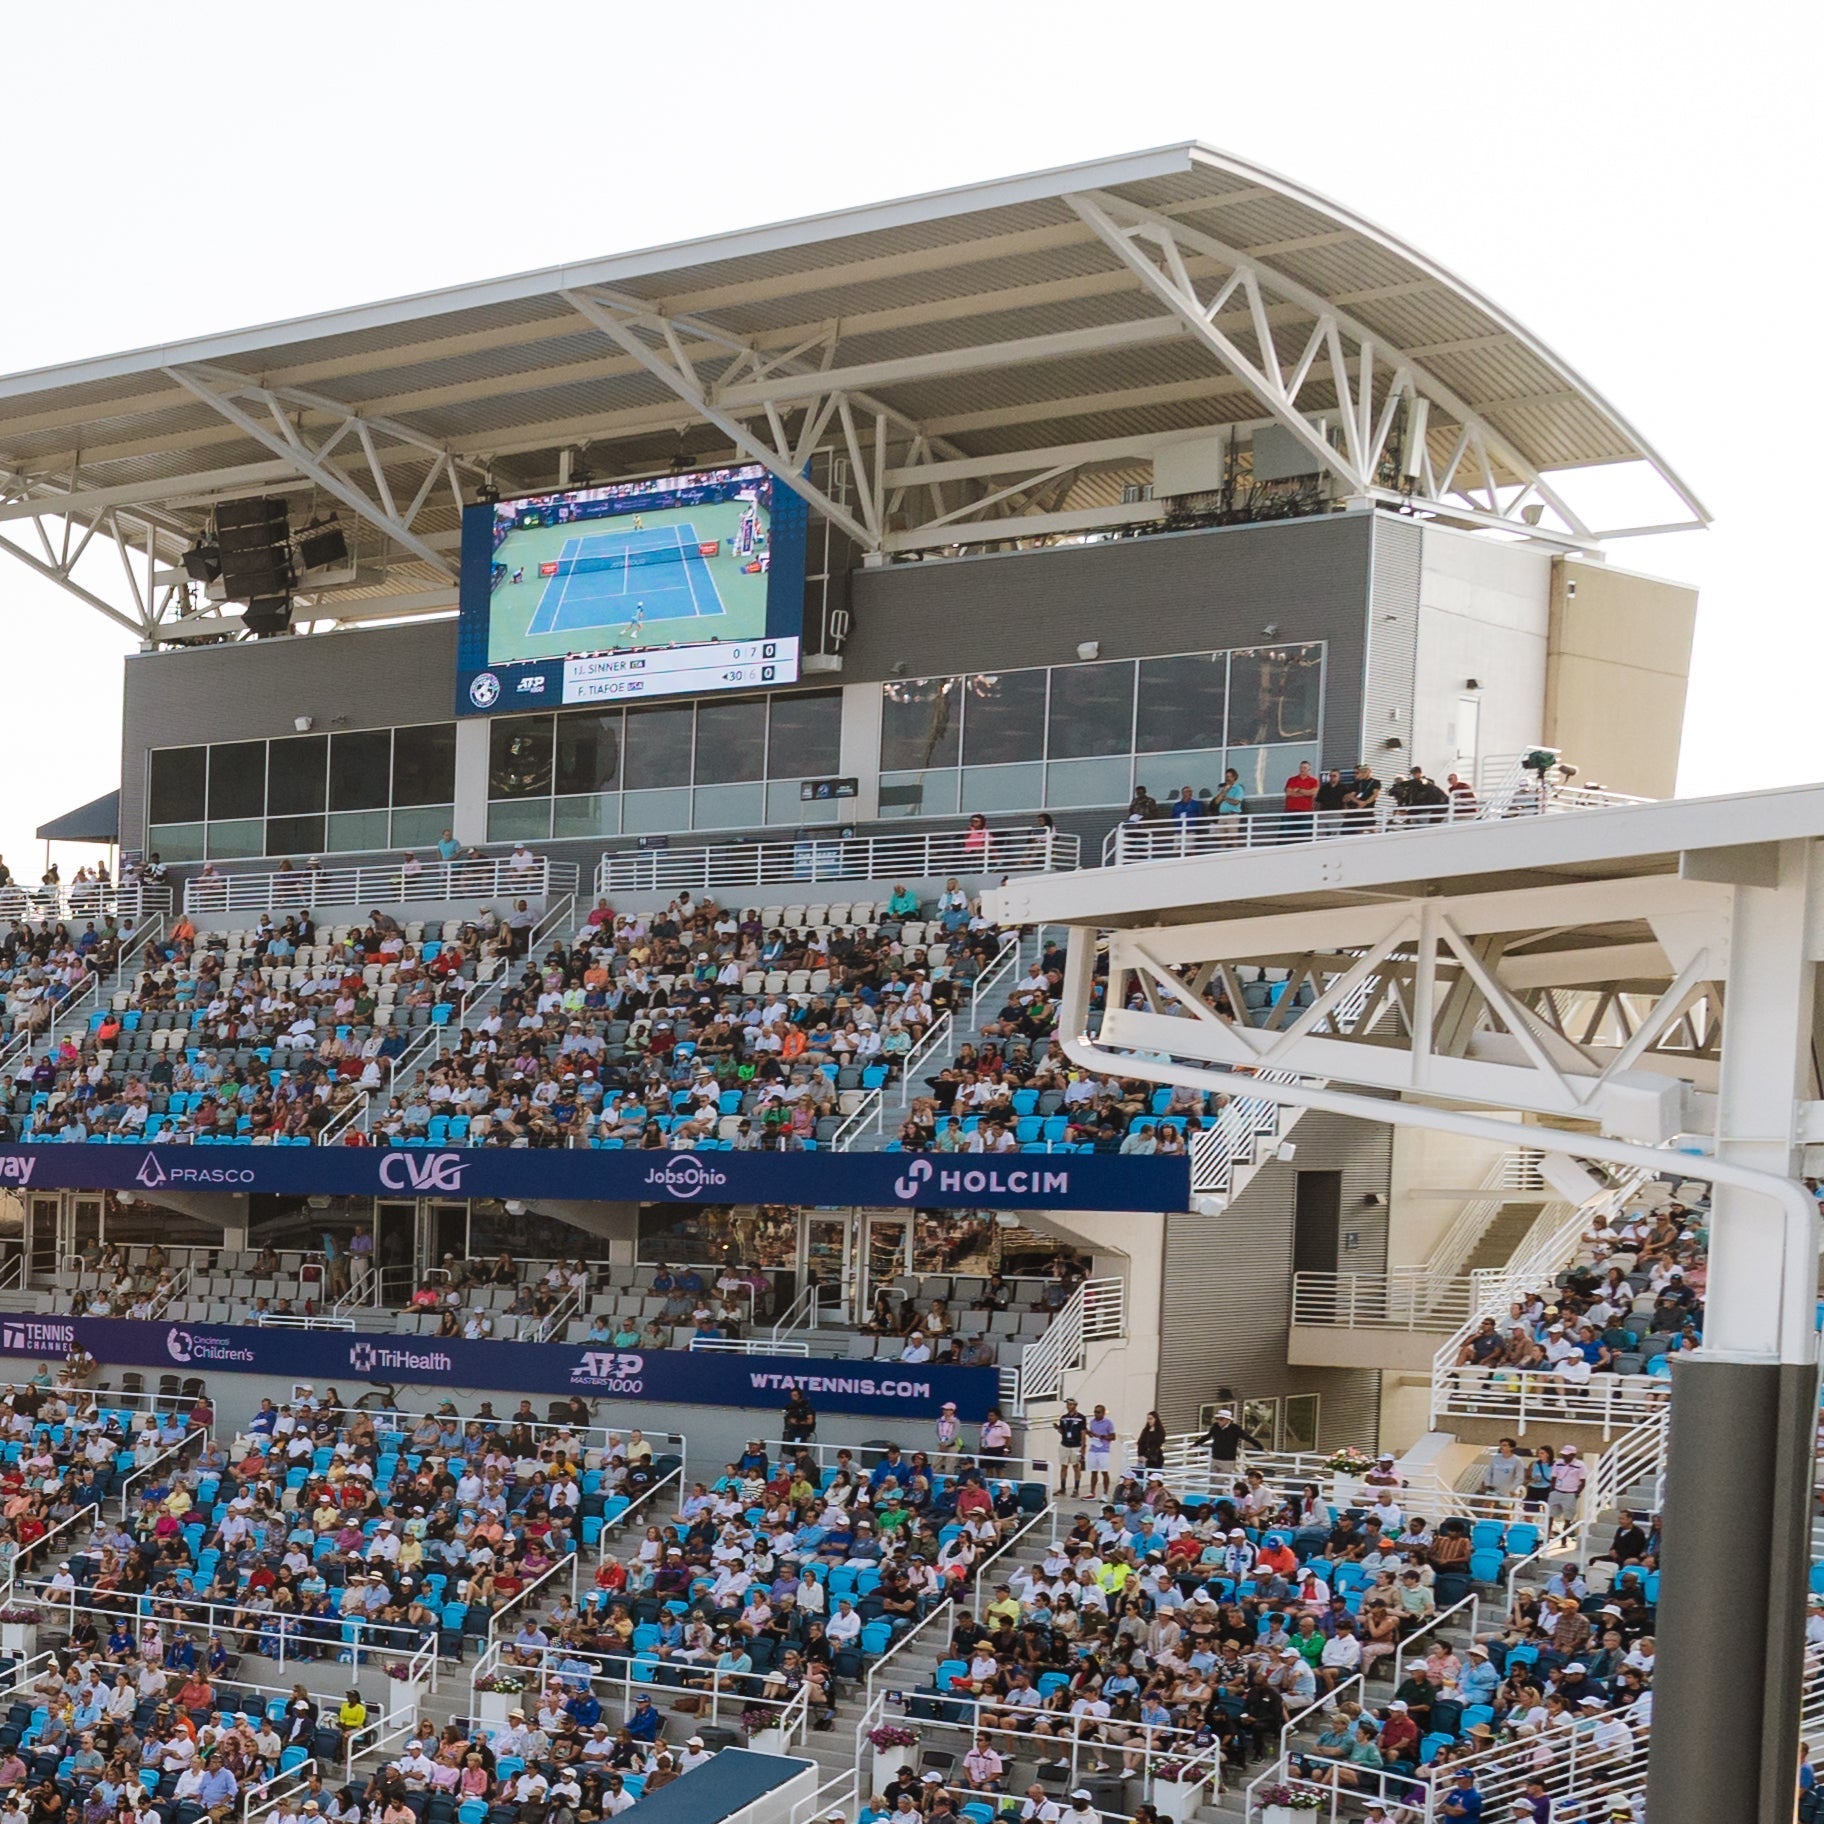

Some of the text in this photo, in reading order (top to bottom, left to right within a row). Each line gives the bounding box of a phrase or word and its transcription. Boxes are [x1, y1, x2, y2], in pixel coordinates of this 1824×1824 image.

[588, 661, 626, 674] SINNER
[733, 648, 740, 659] 0
[750, 647, 757, 657] 7
[765, 644, 775, 657] 0
[589, 683, 624, 695] TIAFOE
[727, 670, 742, 681] 30
[749, 669, 756, 680] 6
[763, 667, 773, 679] 0
[171, 1169, 255, 1183] PRASCO
[379, 1153, 472, 1191] CVG
[645, 1168, 726, 1185] JobsOhio
[940, 1171, 1068, 1193] HOLCIM
[26, 1323, 74, 1342] TENNIS
[193, 1336, 230, 1346] Cincinnati
[193, 1345, 254, 1361] Children's
[378, 1349, 452, 1371] TriHealth
[568, 1352, 644, 1379] ATP
[570, 1376, 643, 1394] MASTERS 1000
[750, 1373, 930, 1398] WTATENNIS.COM
